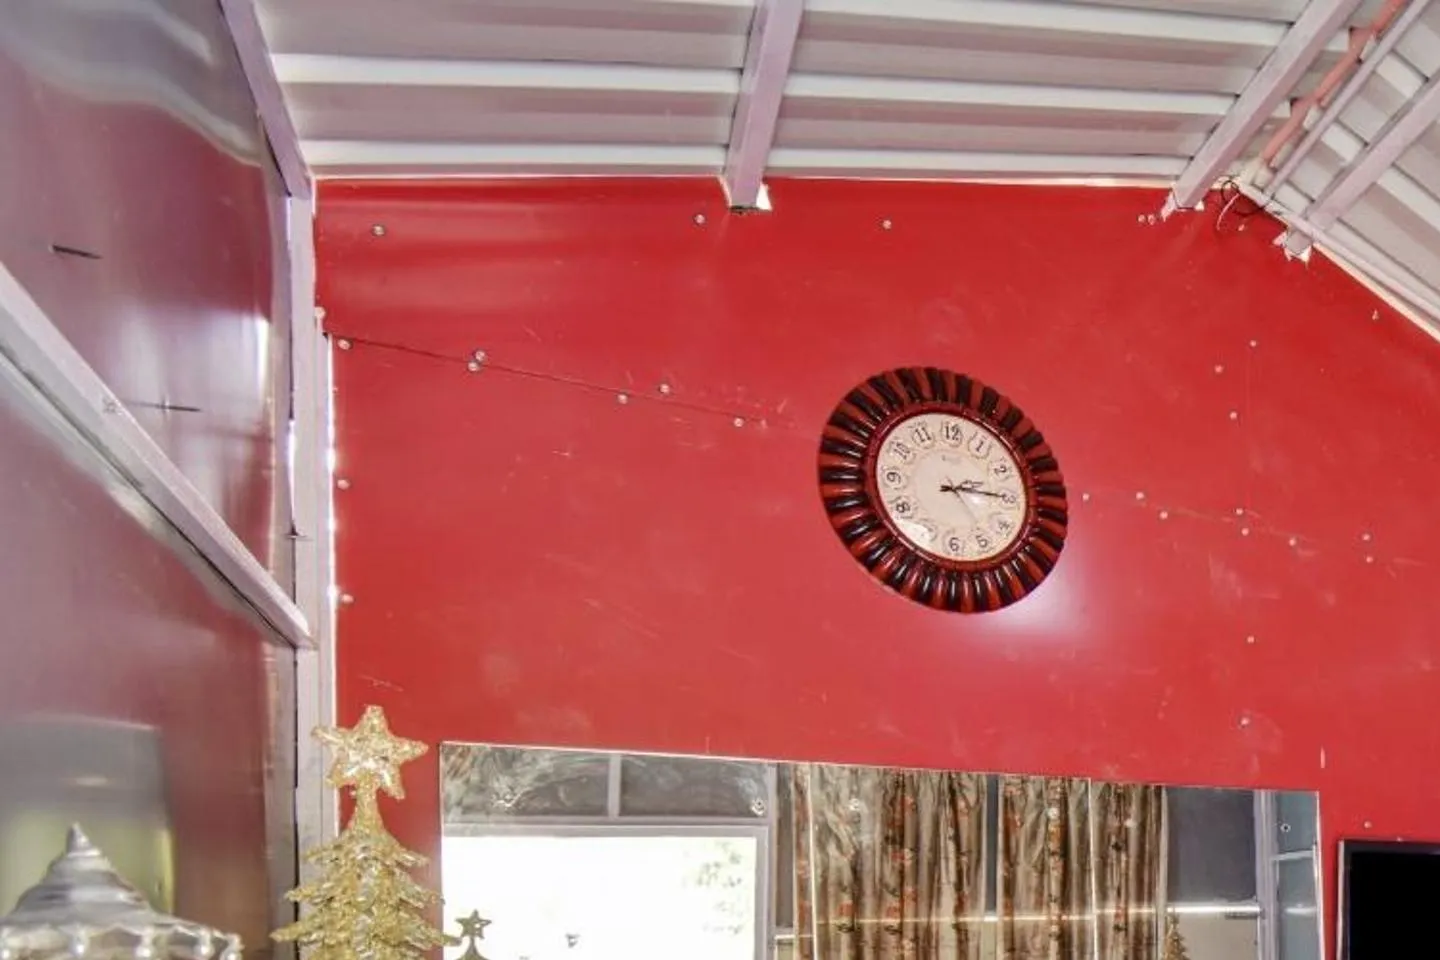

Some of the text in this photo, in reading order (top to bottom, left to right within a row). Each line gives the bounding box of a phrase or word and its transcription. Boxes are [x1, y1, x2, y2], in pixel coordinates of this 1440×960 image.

[915, 427, 931, 443] 11
[945, 424, 960, 441] 12
[894, 441, 911, 460] 10
[976, 440, 984, 452] 1
[886, 472, 902, 482] 9
[994, 465, 1007, 476] 2
[896, 501, 911, 513] 8
[949, 537, 960, 552] 6
[975, 534, 988, 548] 5
